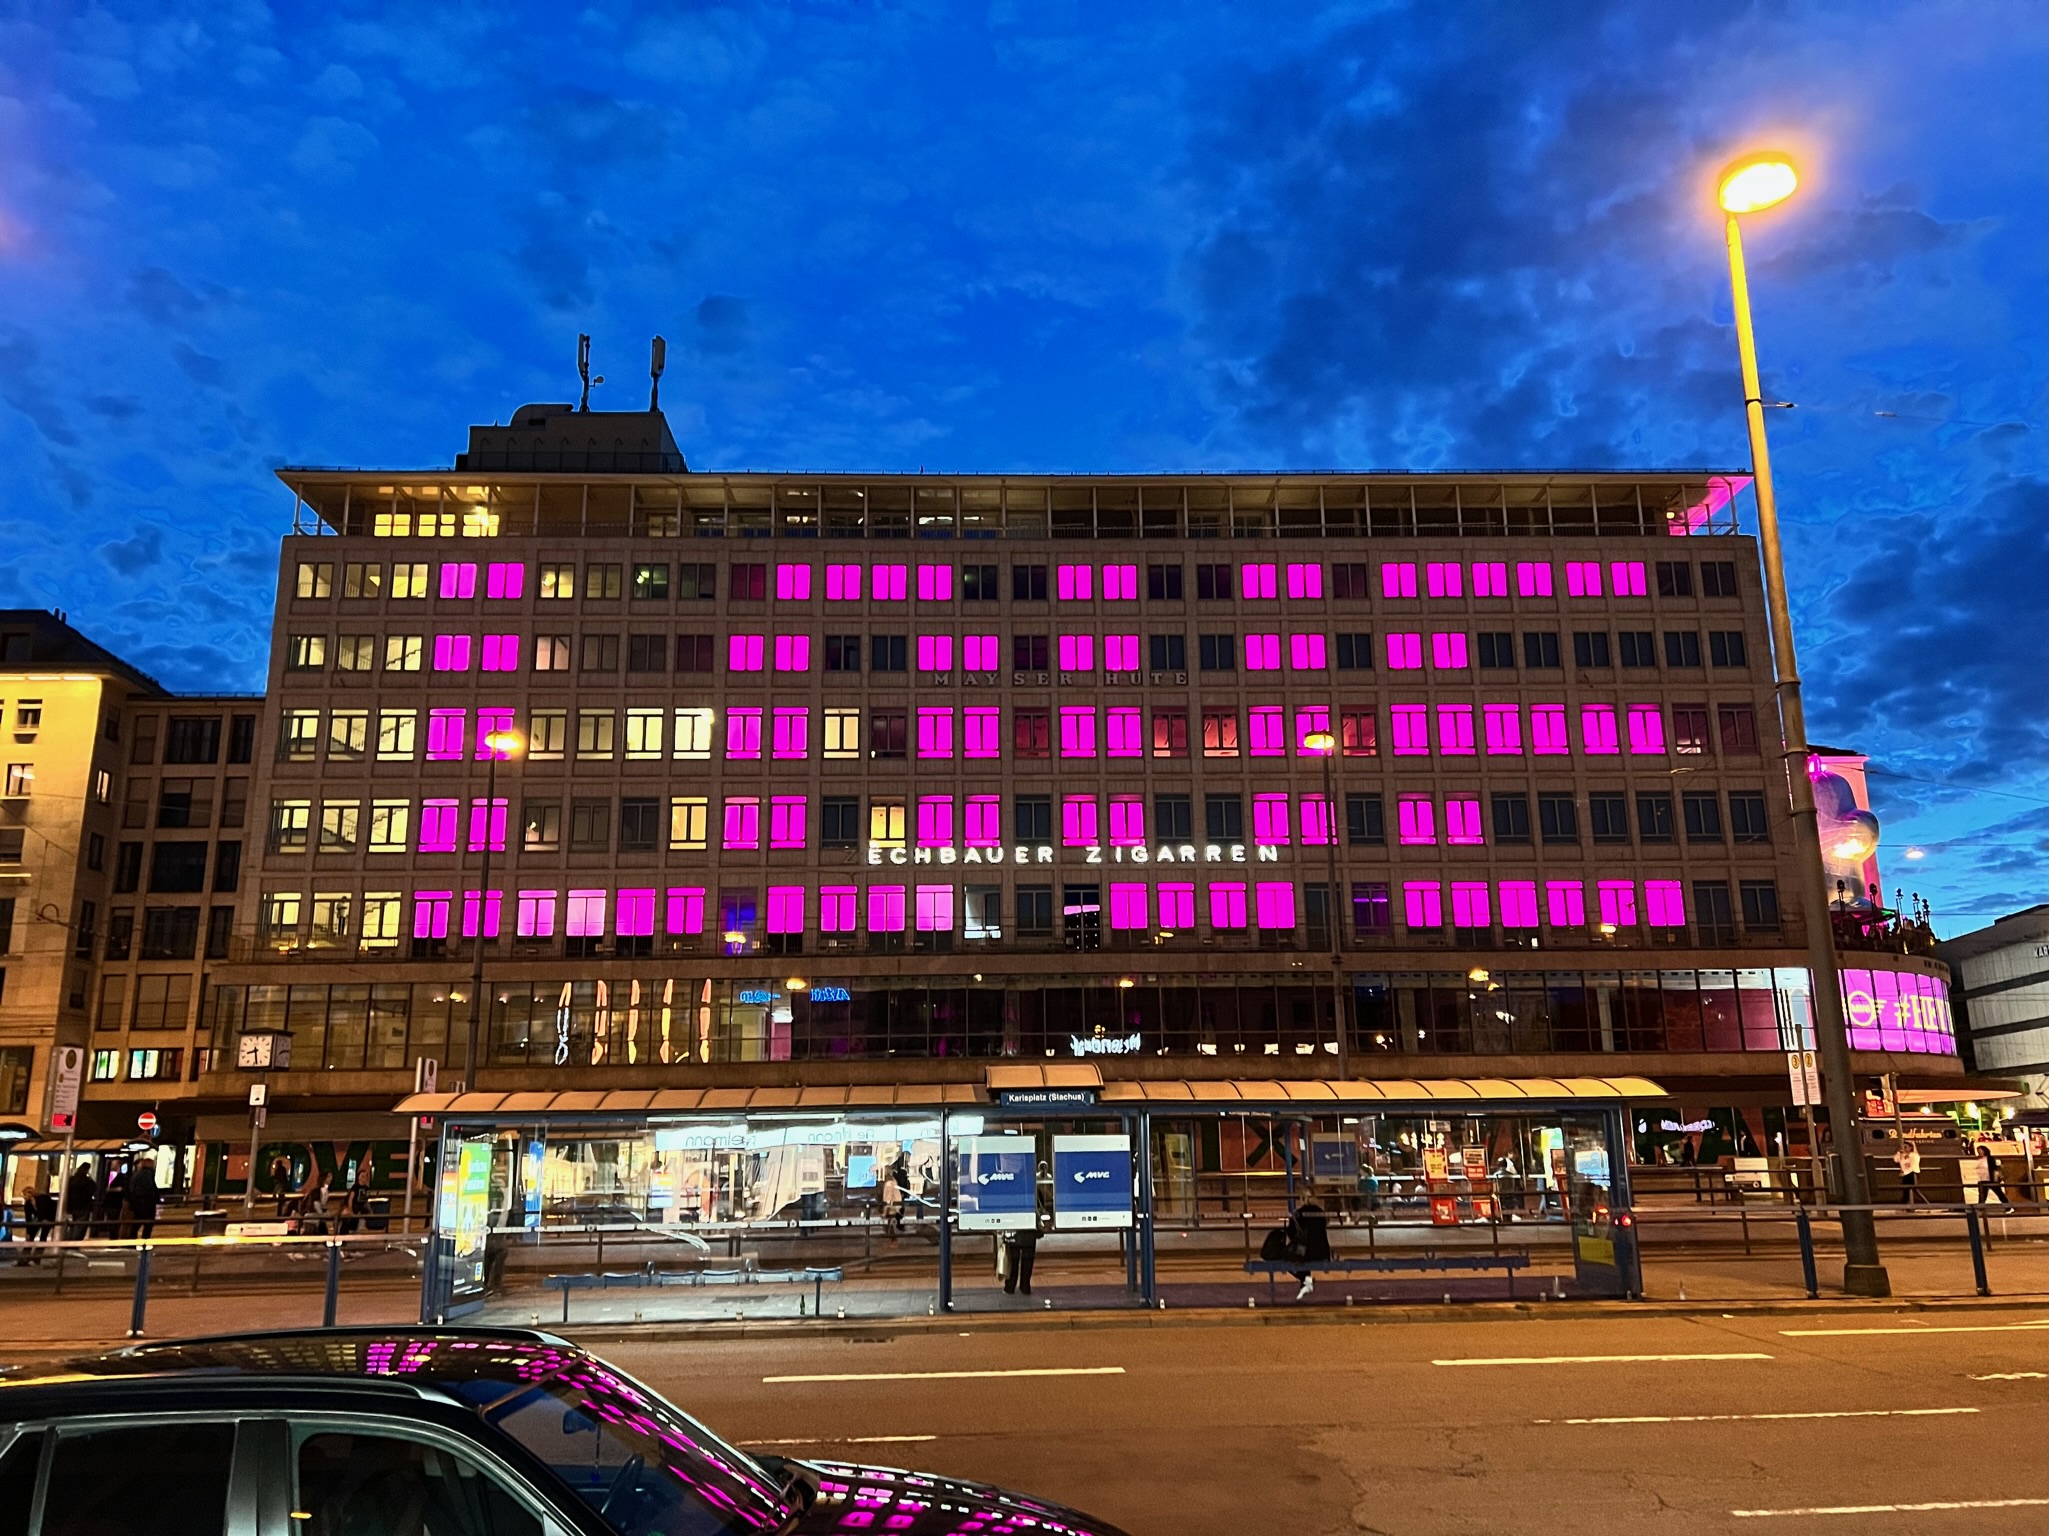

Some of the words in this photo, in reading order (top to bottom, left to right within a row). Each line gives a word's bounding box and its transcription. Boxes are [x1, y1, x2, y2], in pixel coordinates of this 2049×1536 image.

[934, 672, 1073, 686] MAYSER
[1085, 845, 1278, 863] ZIGARREN
[1008, 1093, 1047, 1104] Karlsplatz
[1048, 1092, 1085, 1103] (Stachus)
[1888, 1127, 1943, 1139] Rndfahrten
[1085, 1171, 1110, 1179] MVG
